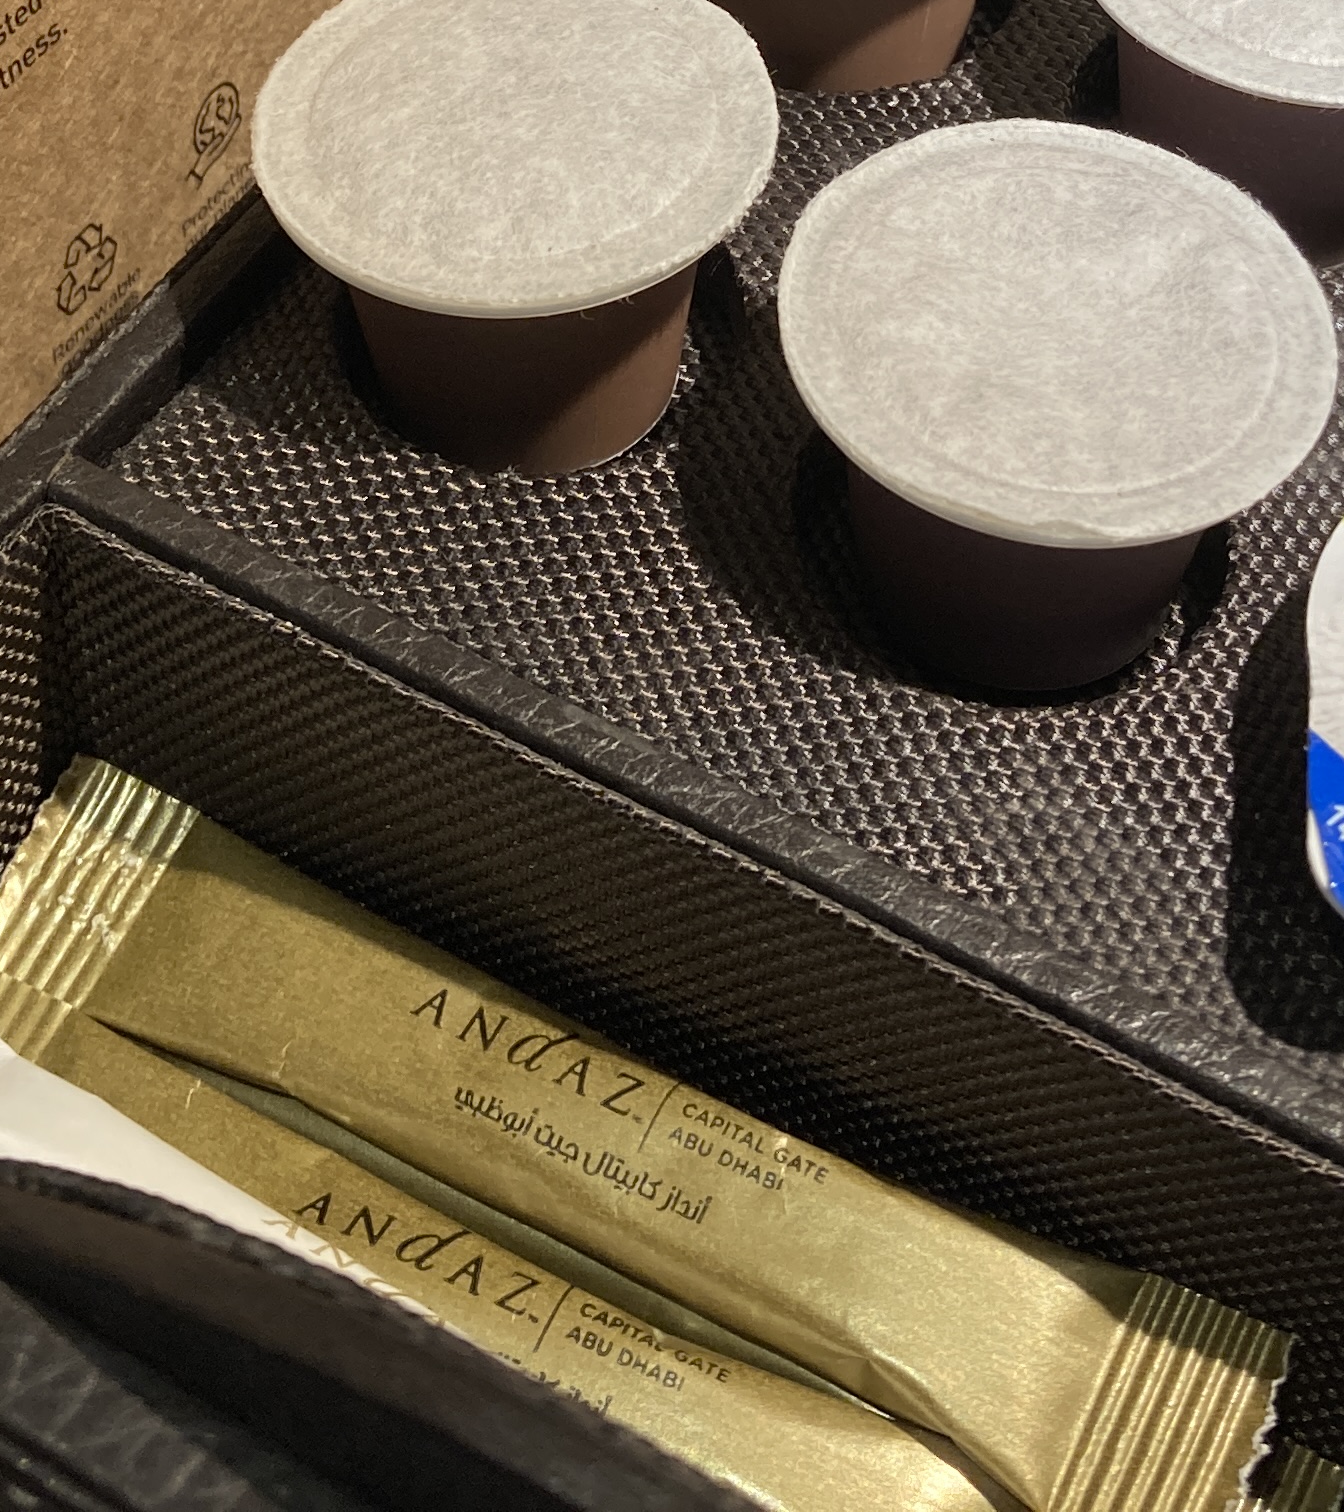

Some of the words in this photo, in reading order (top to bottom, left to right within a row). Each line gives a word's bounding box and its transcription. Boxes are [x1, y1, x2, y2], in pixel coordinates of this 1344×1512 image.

[667, 1126, 711, 1158] ABU
[716, 1149, 785, 1191] DHABI
[681, 1102, 763, 1155] CAPITAL
[773, 1149, 829, 1185] GATE
[565, 1326, 613, 1356] ABU
[616, 1347, 684, 1391] DHABI
[674, 1350, 731, 1383] GATE
